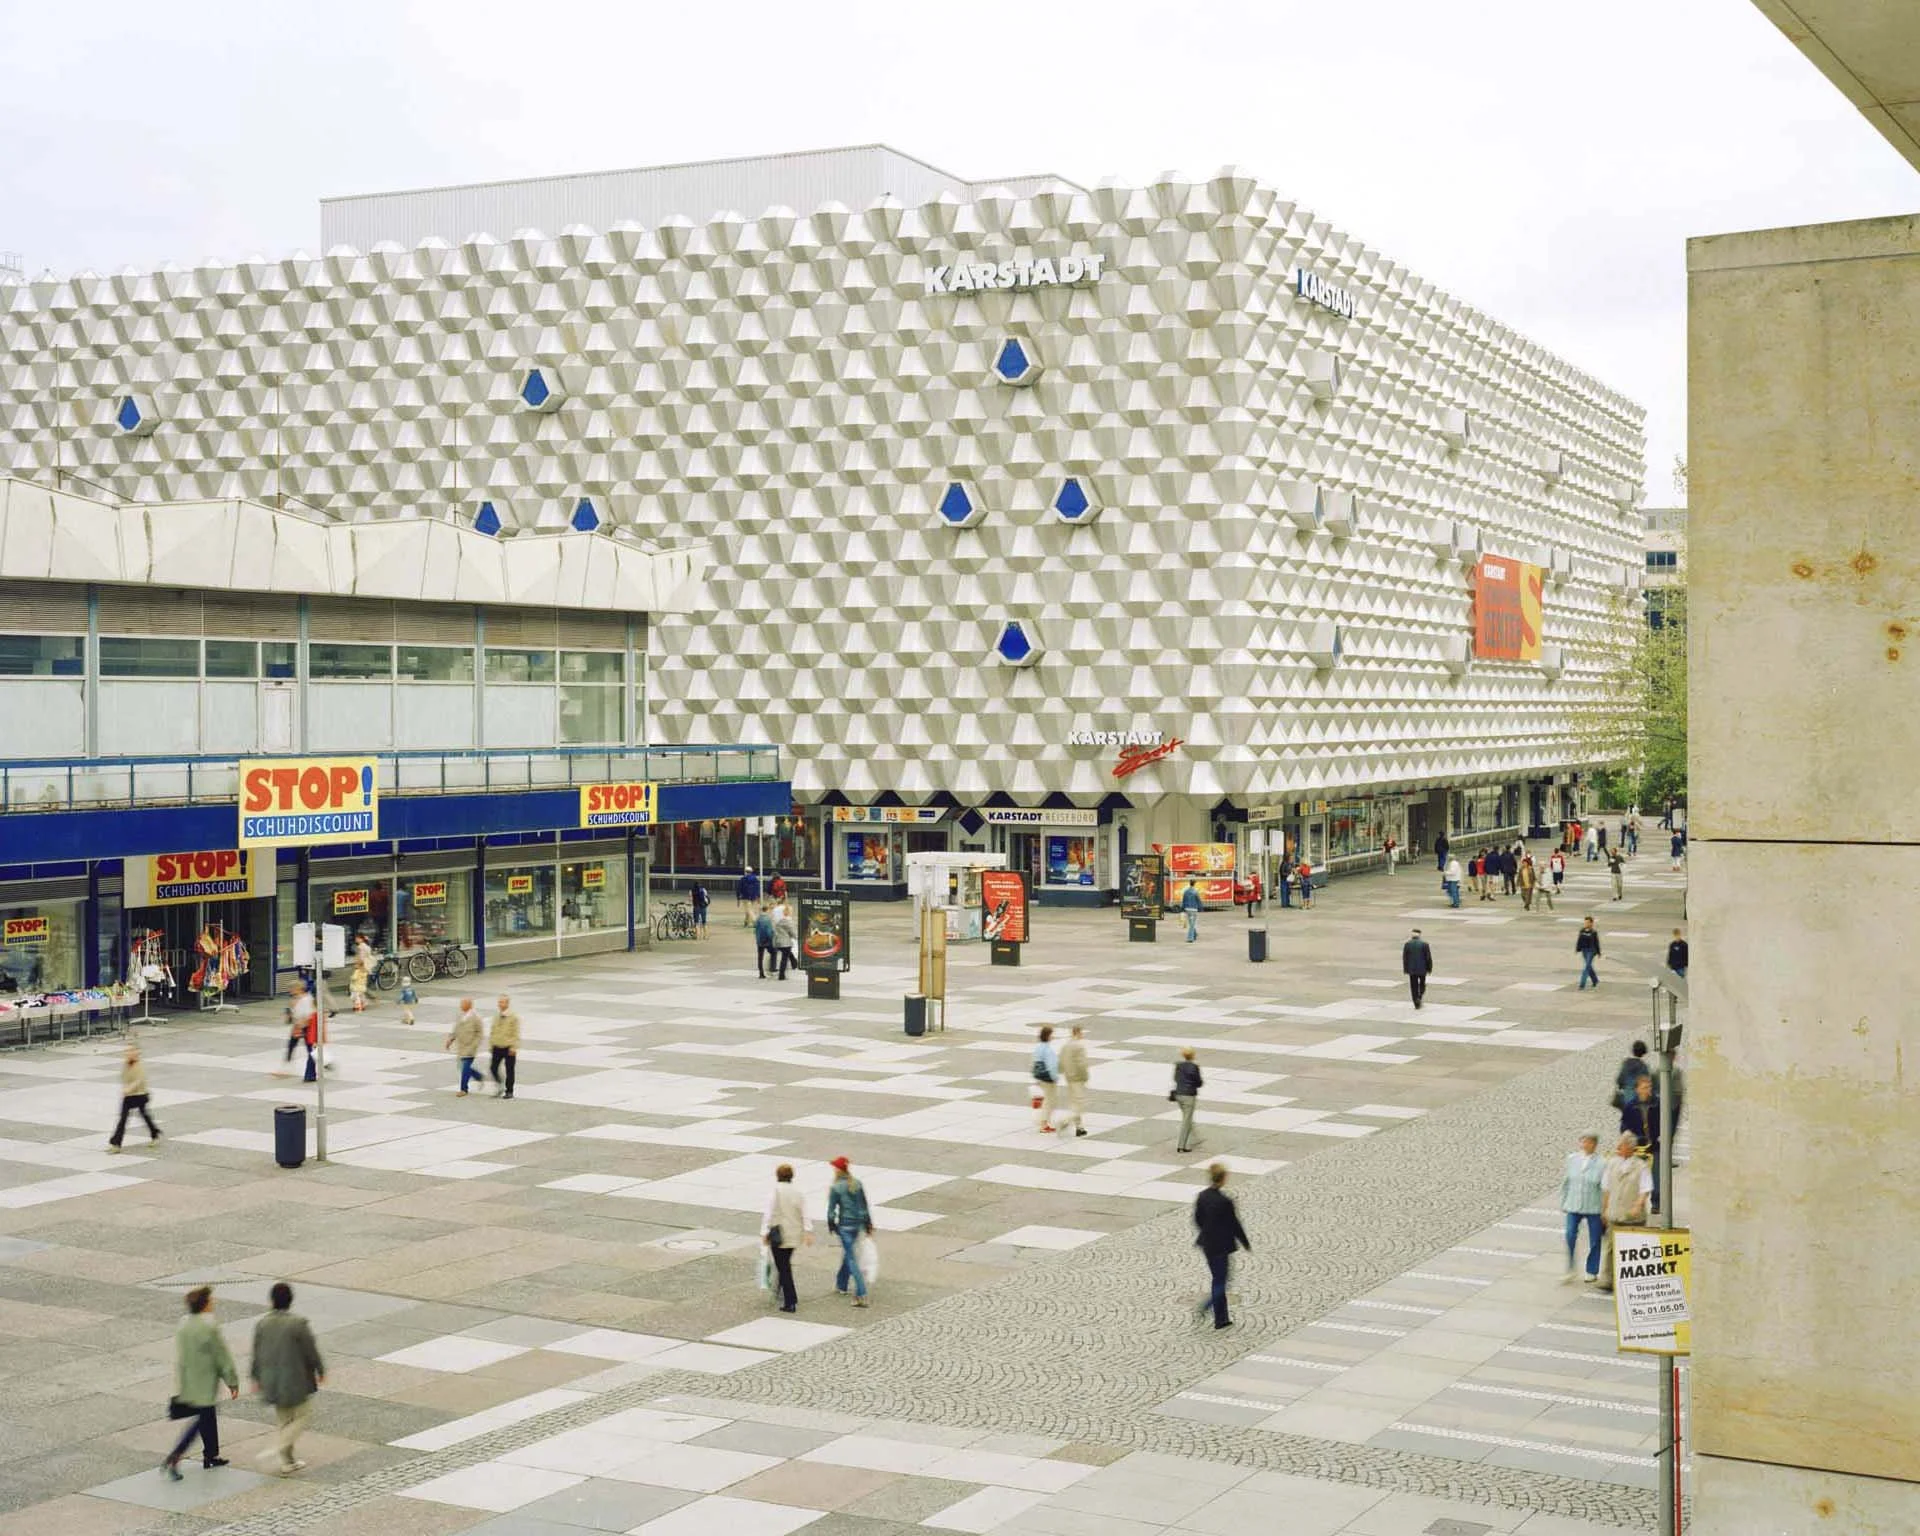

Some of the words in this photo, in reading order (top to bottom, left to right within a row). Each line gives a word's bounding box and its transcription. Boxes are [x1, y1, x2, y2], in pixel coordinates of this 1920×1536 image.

[924, 254, 1105, 293] KARSTADT
[1298, 268, 1357, 319] KARSTADT
[1069, 730, 1164, 745] KARSTADT
[1112, 737, 1184, 778] Sport
[244, 766, 373, 812] STOP!
[588, 785, 651, 811] STOP!
[589, 812, 649, 825] SCHUHDISCOUNT
[988, 812, 1042, 821] KARSTADT
[247, 813, 370, 837] SCHUHDISCOUNT
[157, 850, 248, 882] STOP!
[158, 880, 246, 898] SCHUHDISCOUNT
[416, 884, 445, 897] STOP!
[336, 891, 367, 905] STOP!
[7, 919, 47, 934] STOP!
[1619, 1261, 1678, 1280] MARKT
[1629, 1291, 1653, 1301] Prager
[1655, 1288, 1681, 1298] Straße
[1636, 1282, 1671, 1292] Dresden
[1647, 1303, 1685, 1315] 01.05.05
